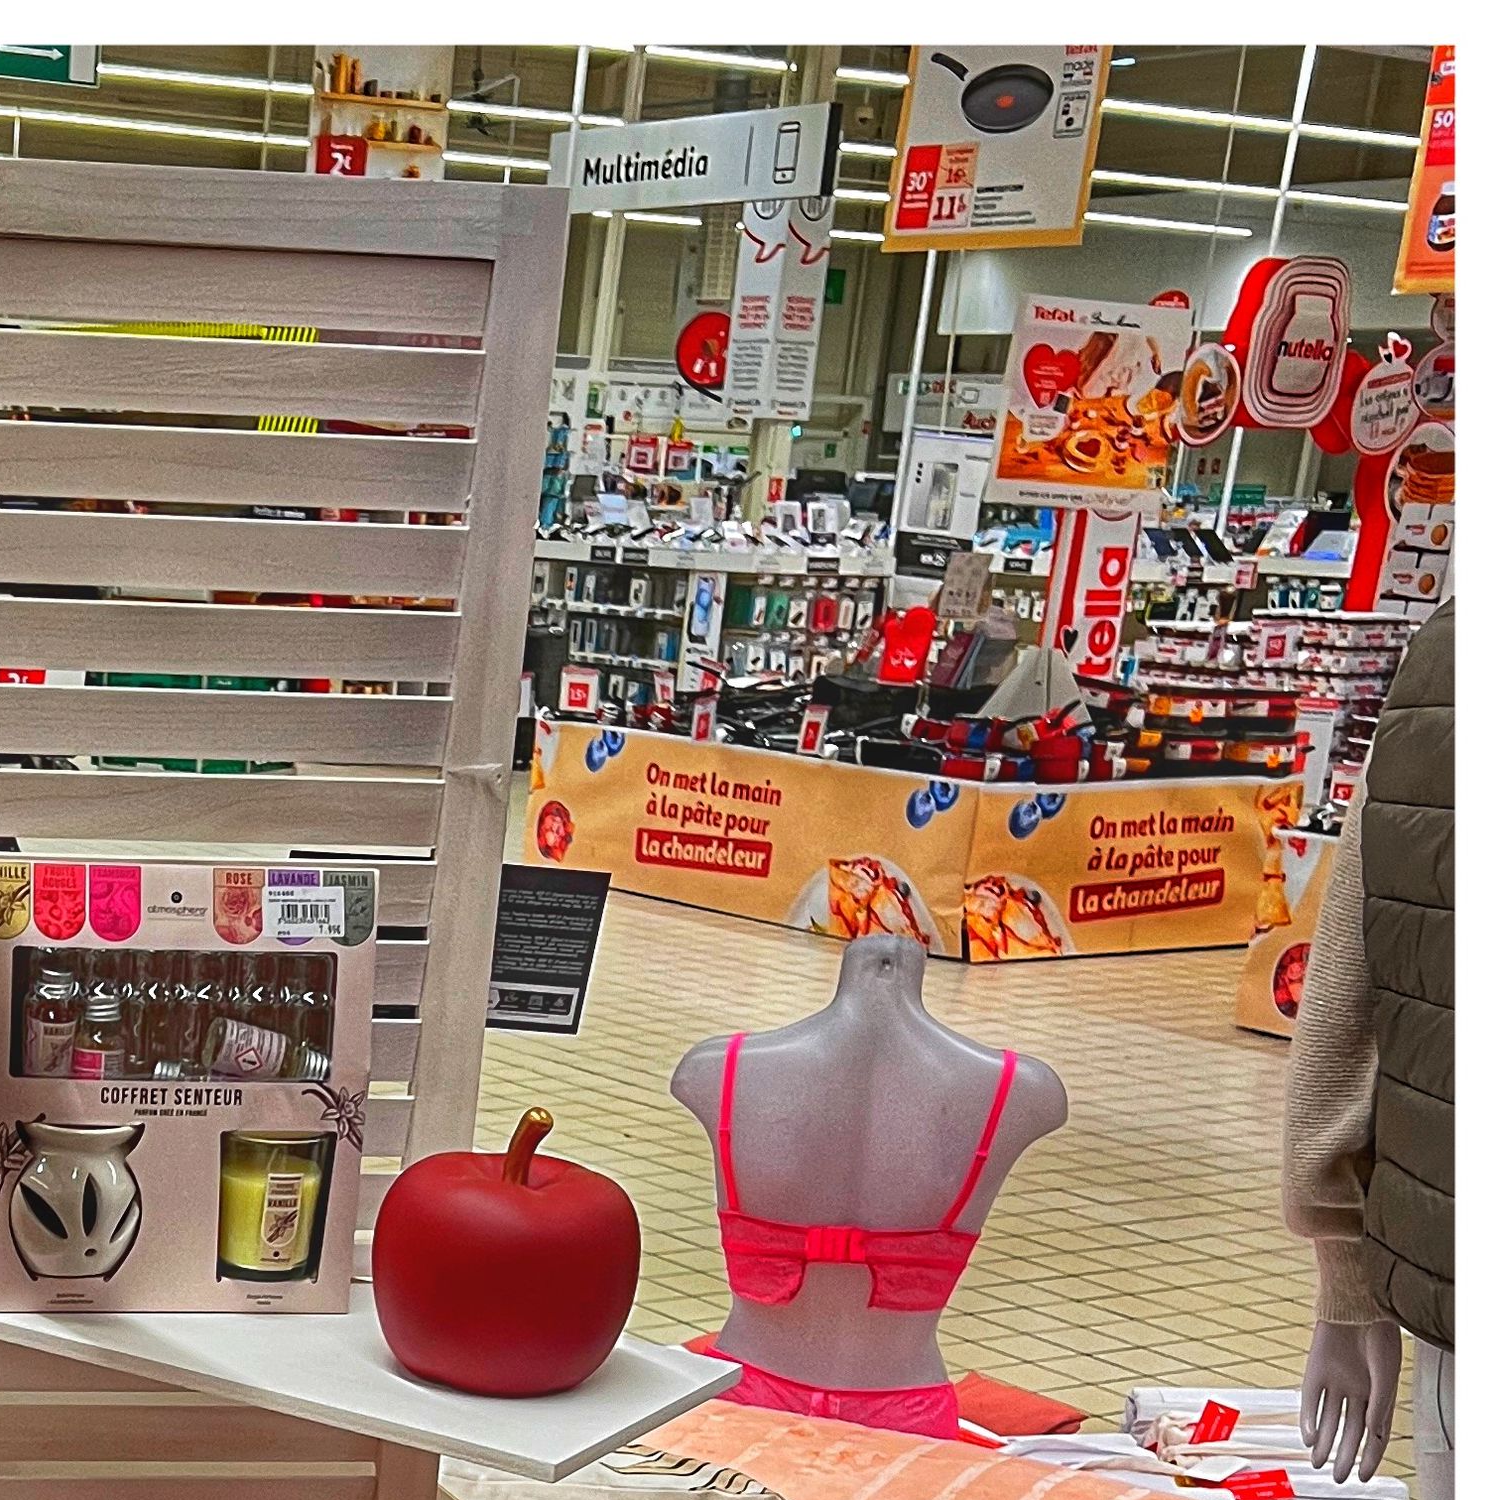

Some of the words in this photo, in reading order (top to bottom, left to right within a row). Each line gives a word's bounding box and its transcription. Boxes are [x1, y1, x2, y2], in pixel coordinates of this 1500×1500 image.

[583, 146, 709, 186] Multimédia
[1033, 305, 1076, 323] Tefal
[1277, 339, 1333, 362] nutella
[646, 763, 671, 785] On
[673, 770, 709, 794] met
[711, 771, 730, 797] la
[732, 780, 782, 807] main
[646, 793, 658, 817] à
[660, 796, 678, 820] la
[680, 797, 722, 832] pâte
[723, 812, 770, 838] pour
[1090, 815, 1117, 841] On
[1120, 813, 1155, 839] met
[1156, 811, 1178, 836] la
[1181, 807, 1235, 833] main
[641, 829, 660, 855] la
[661, 833, 767, 871] chandeleur
[1088, 845, 1102, 872] à
[1104, 846, 1128, 871] la
[1129, 844, 1173, 877] pâte
[1177, 843, 1222, 873] pour
[225, 871, 252, 886] ROSE
[269, 871, 320, 886] LAVANDE
[327, 873, 369, 888] JASMIN
[1076, 886, 1099, 914] la
[1101, 875, 1221, 912] chandeleur
[100, 1087, 168, 1105] COFFRET
[174, 1088, 243, 1106] SENTEUR
